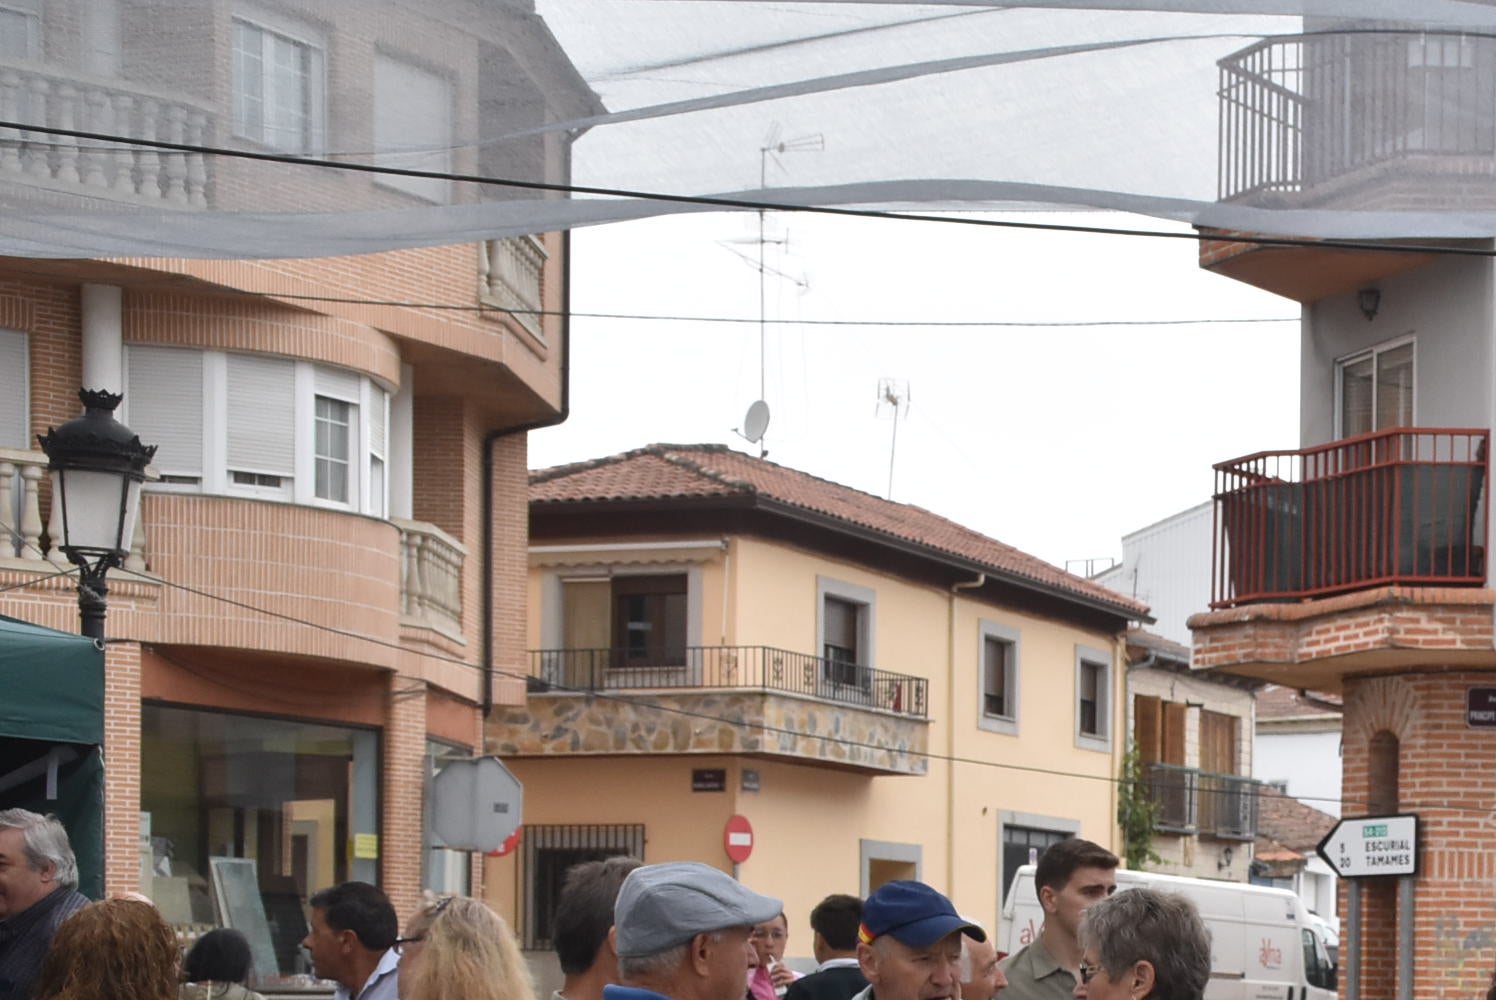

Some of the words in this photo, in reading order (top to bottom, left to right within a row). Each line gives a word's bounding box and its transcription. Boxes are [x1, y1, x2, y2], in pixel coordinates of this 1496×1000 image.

[1365, 839, 1411, 852] ESCURIAL
[1340, 857, 1352, 868] 20
[1366, 855, 1410, 867] TAMAMES
